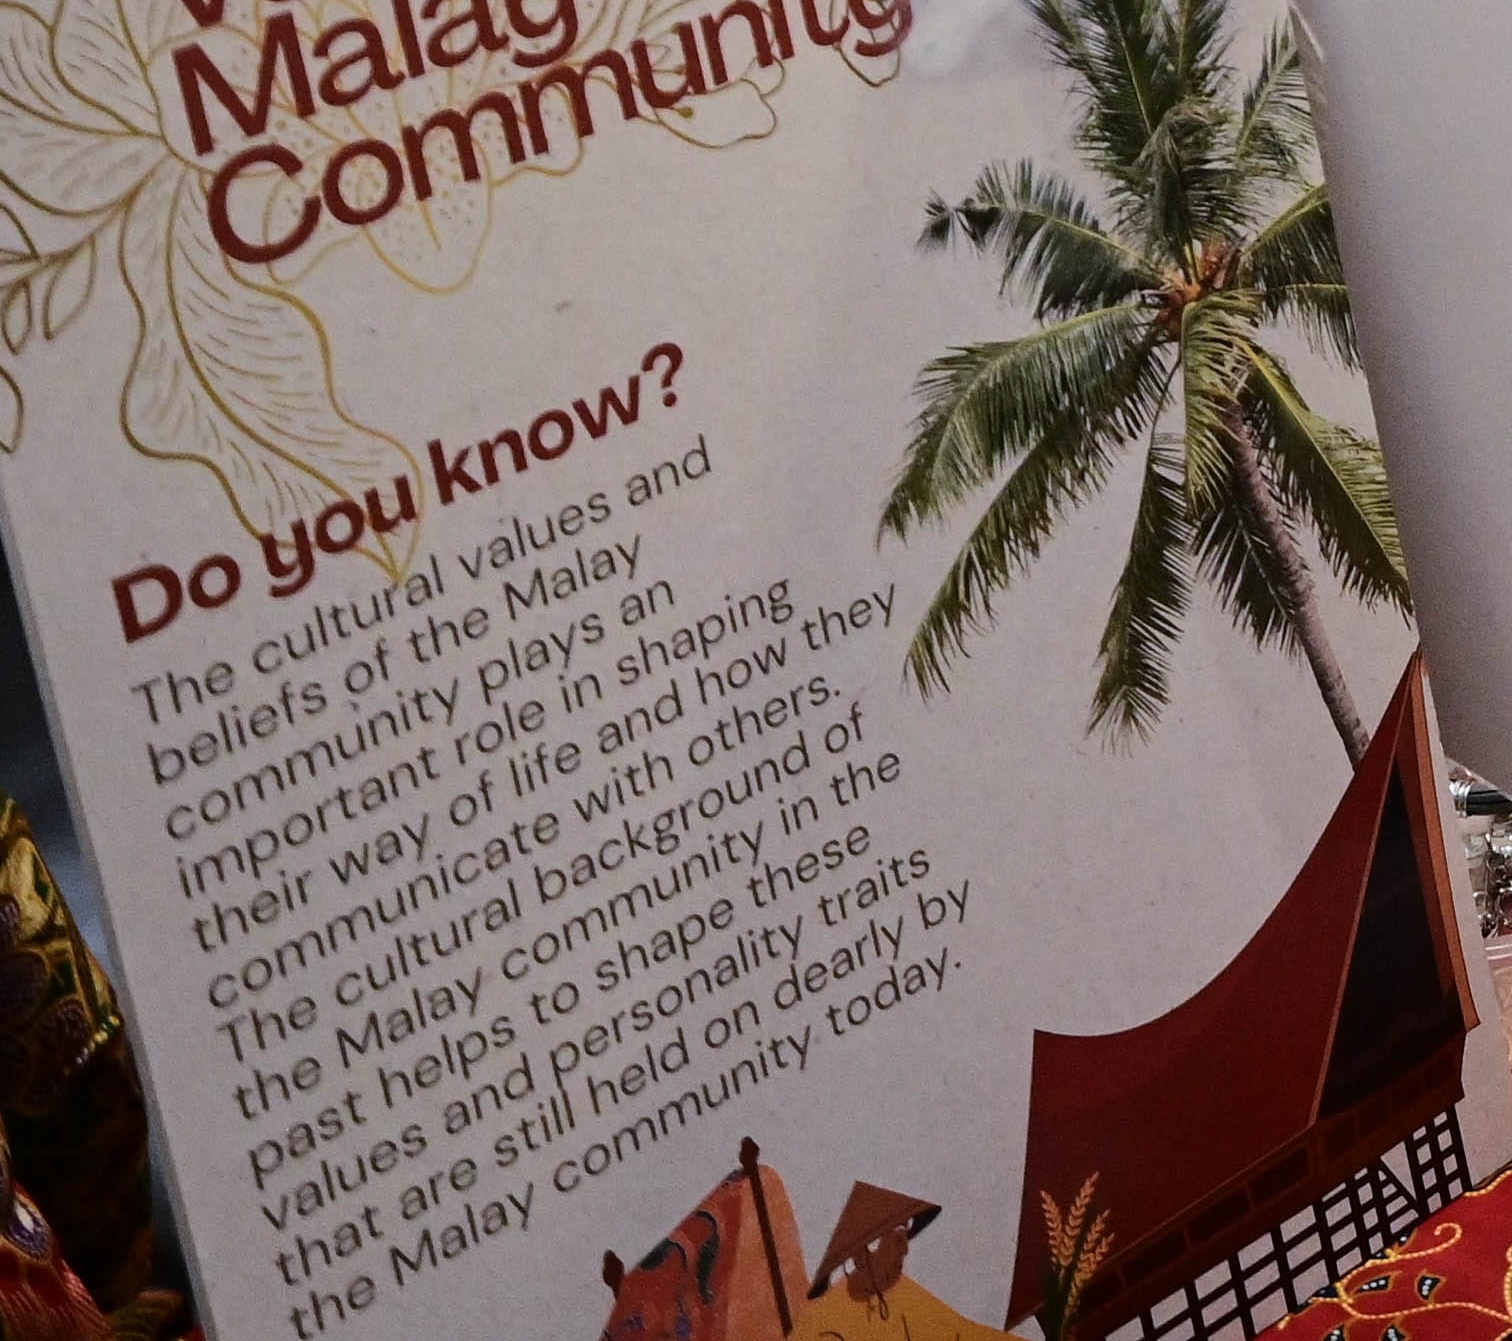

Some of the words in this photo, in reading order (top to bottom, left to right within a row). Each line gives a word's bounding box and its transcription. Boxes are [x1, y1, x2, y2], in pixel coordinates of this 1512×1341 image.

[110, 551, 242, 644] Do
[257, 469, 420, 597] you
[425, 342, 685, 508] know?
[130, 661, 236, 726] The
[251, 553, 446, 675] cultural
[456, 491, 613, 581] values
[624, 432, 712, 508] and
[145, 680, 328, 788] beliefs
[343, 636, 390, 696] of
[406, 606, 491, 665] the
[502, 533, 641, 623] Malay
[165, 677, 460, 842] community
[476, 612, 606, 707] plays
[619, 579, 676, 627] an
[176, 746, 441, 901] important
[453, 699, 546, 768] role
[557, 673, 603, 715] in
[615, 578, 795, 687] shaping
[190, 869, 313, 954] their
[328, 812, 430, 887] way
[448, 768, 494, 829] of
[508, 741, 582, 799] life
[596, 677, 685, 756] and
[693, 636, 787, 707] how
[800, 582, 896, 652] they
[207, 812, 561, 1010] communicate
[572, 750, 675, 824] with
[687, 675, 841, 768] others.
[216, 995, 318, 1065] The
[334, 877, 522, 1008] cultural
[533, 729, 811, 906] background
[823, 700, 863, 755] of
[231, 1056, 322, 1122] the
[334, 966, 483, 1071] Malay
[500, 819, 764, 983] community
[779, 795, 820, 837] in
[828, 752, 901, 808] the
[247, 1090, 368, 1192] past
[376, 1015, 518, 1110] helps
[527, 981, 581, 1026] to
[594, 897, 735, 993] shape
[745, 824, 871, 909] these
[260, 1123, 428, 1232] values
[442, 1051, 536, 1136] and
[582, 914, 804, 1058] personality
[816, 848, 931, 928] traits
[274, 1205, 385, 1287] that
[398, 1157, 478, 1222] are
[493, 1095, 565, 1169] still
[586, 1025, 691, 1117] held
[703, 1000, 761, 1050] on
[772, 914, 904, 1012] dearly
[916, 878, 970, 931] by
[288, 1274, 376, 1338] the
[388, 1181, 535, 1290] Malay
[552, 1024, 812, 1194] community
[825, 946, 962, 1037] today.
